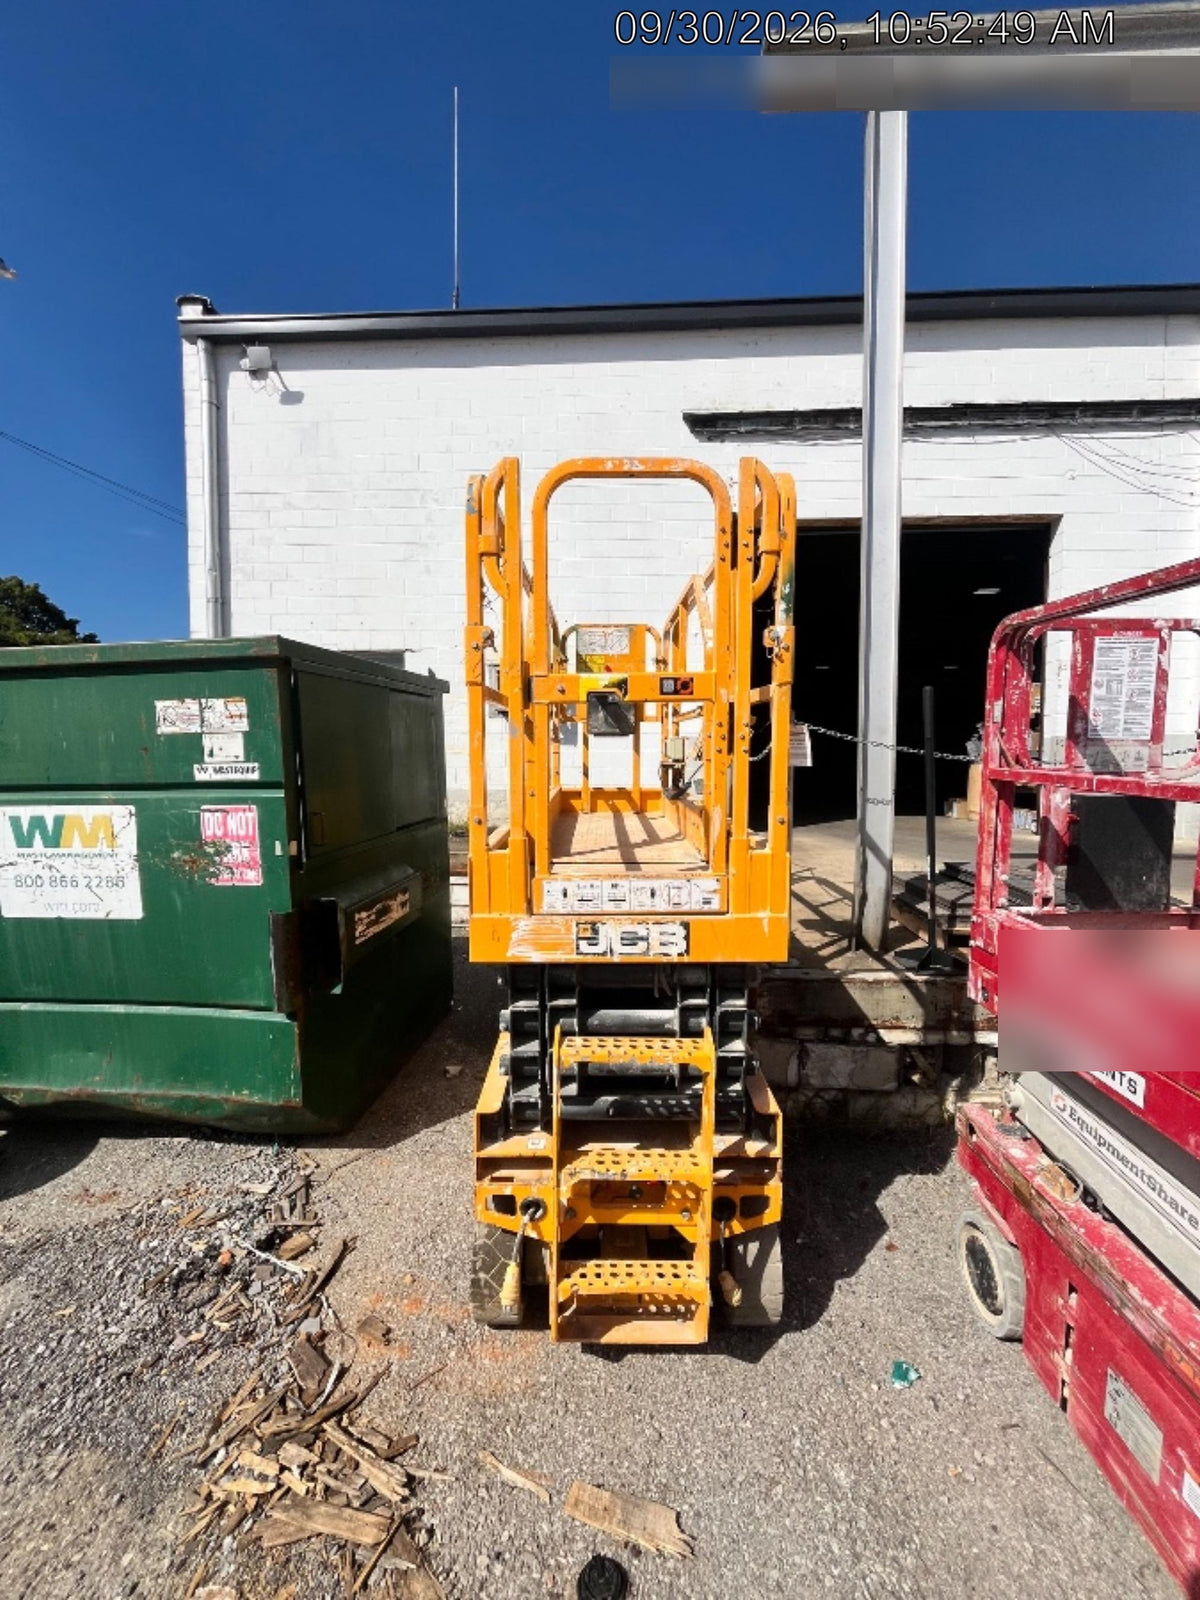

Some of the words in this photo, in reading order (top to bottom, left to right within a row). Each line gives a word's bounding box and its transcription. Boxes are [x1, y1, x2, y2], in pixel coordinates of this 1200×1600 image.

[8, 814, 119, 849] WM
[227, 811, 255, 837] NOT
[14, 874, 45, 888] 800
[49, 874, 79, 888] 866
[577, 923, 688, 954] JCB
[1099, 1071, 1138, 1096] NTS
[1069, 1104, 1200, 1231] EquipmentShare
